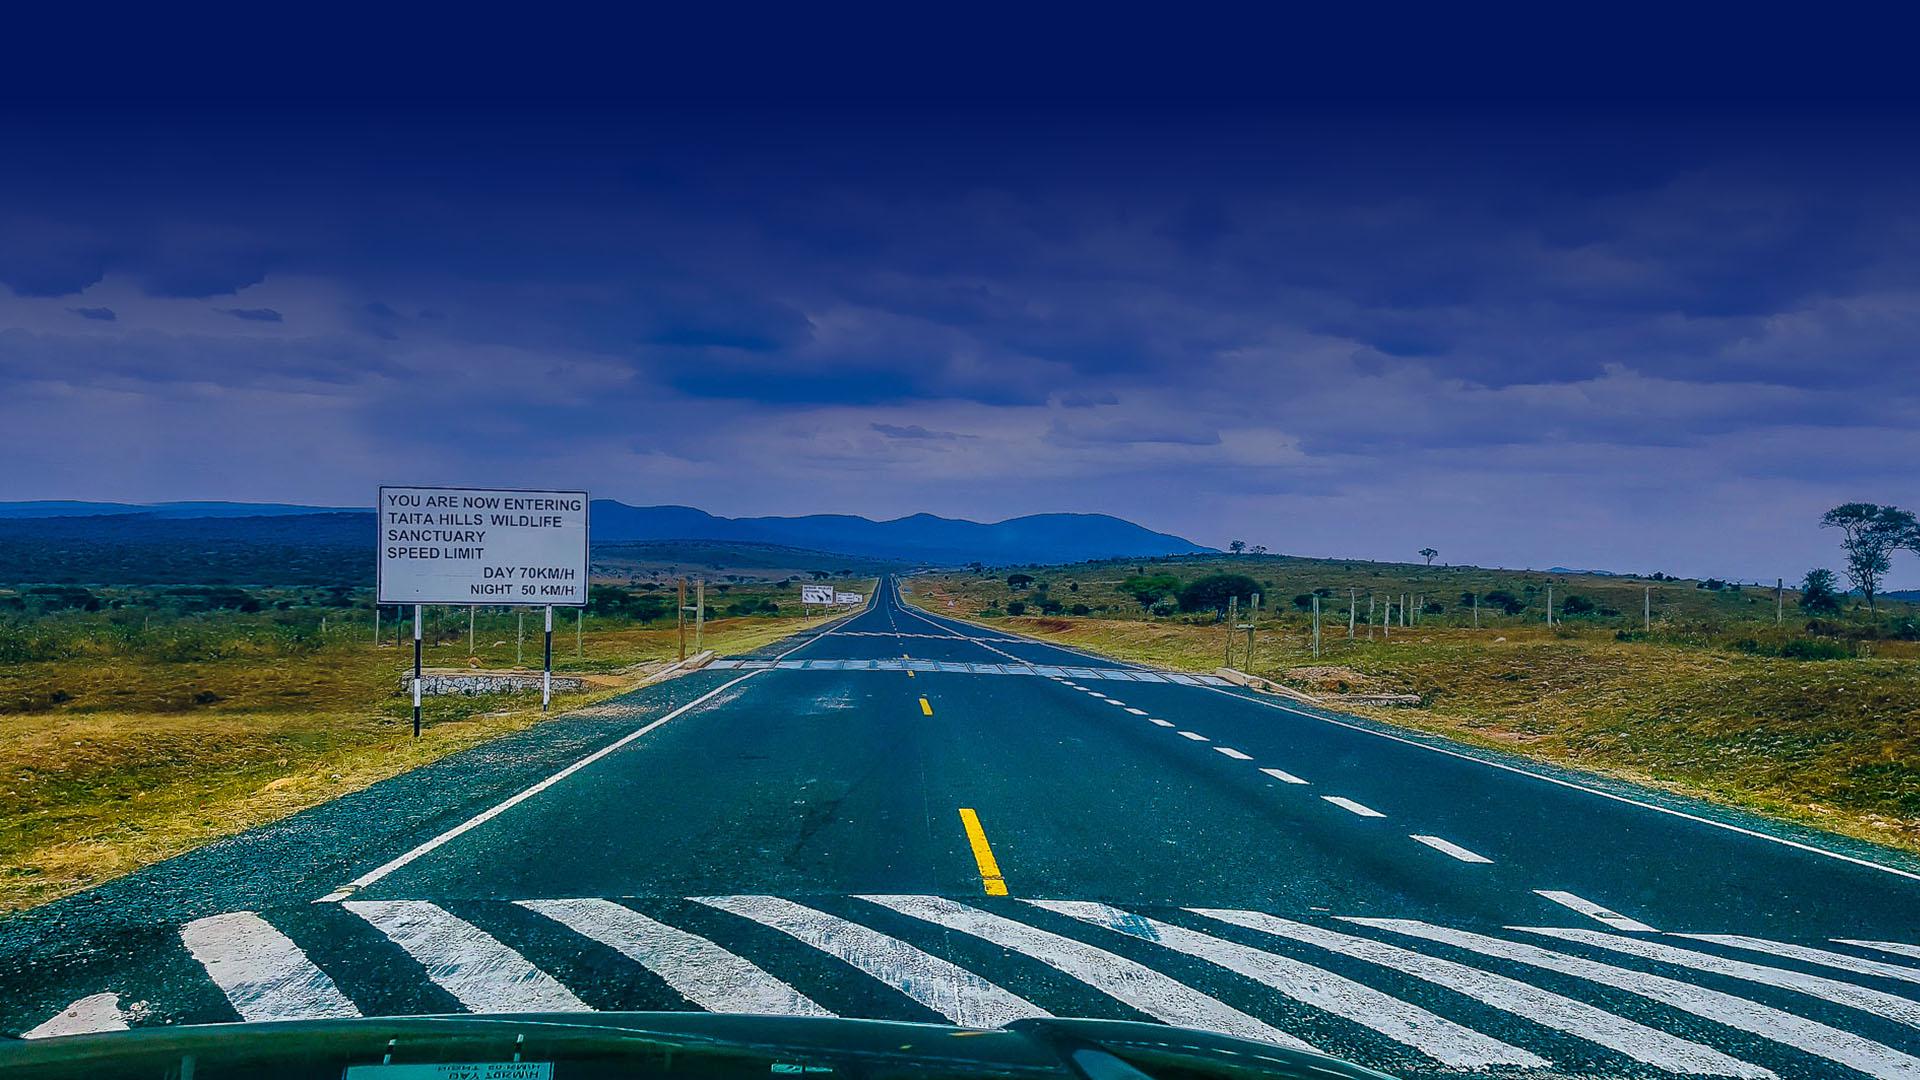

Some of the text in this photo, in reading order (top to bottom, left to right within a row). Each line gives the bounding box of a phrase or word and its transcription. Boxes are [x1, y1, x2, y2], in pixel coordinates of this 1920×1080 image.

[388, 495, 581, 511] YOU ARE NOW ENTERING
[388, 512, 562, 528] TAITA HILLS WILDLIFE
[388, 530, 486, 542] SANCTUARY
[387, 547, 484, 559] SPEED LIMIT
[483, 567, 575, 580] DAY 70KM/H
[470, 584, 575, 596] NIGHT 50 KM/H
